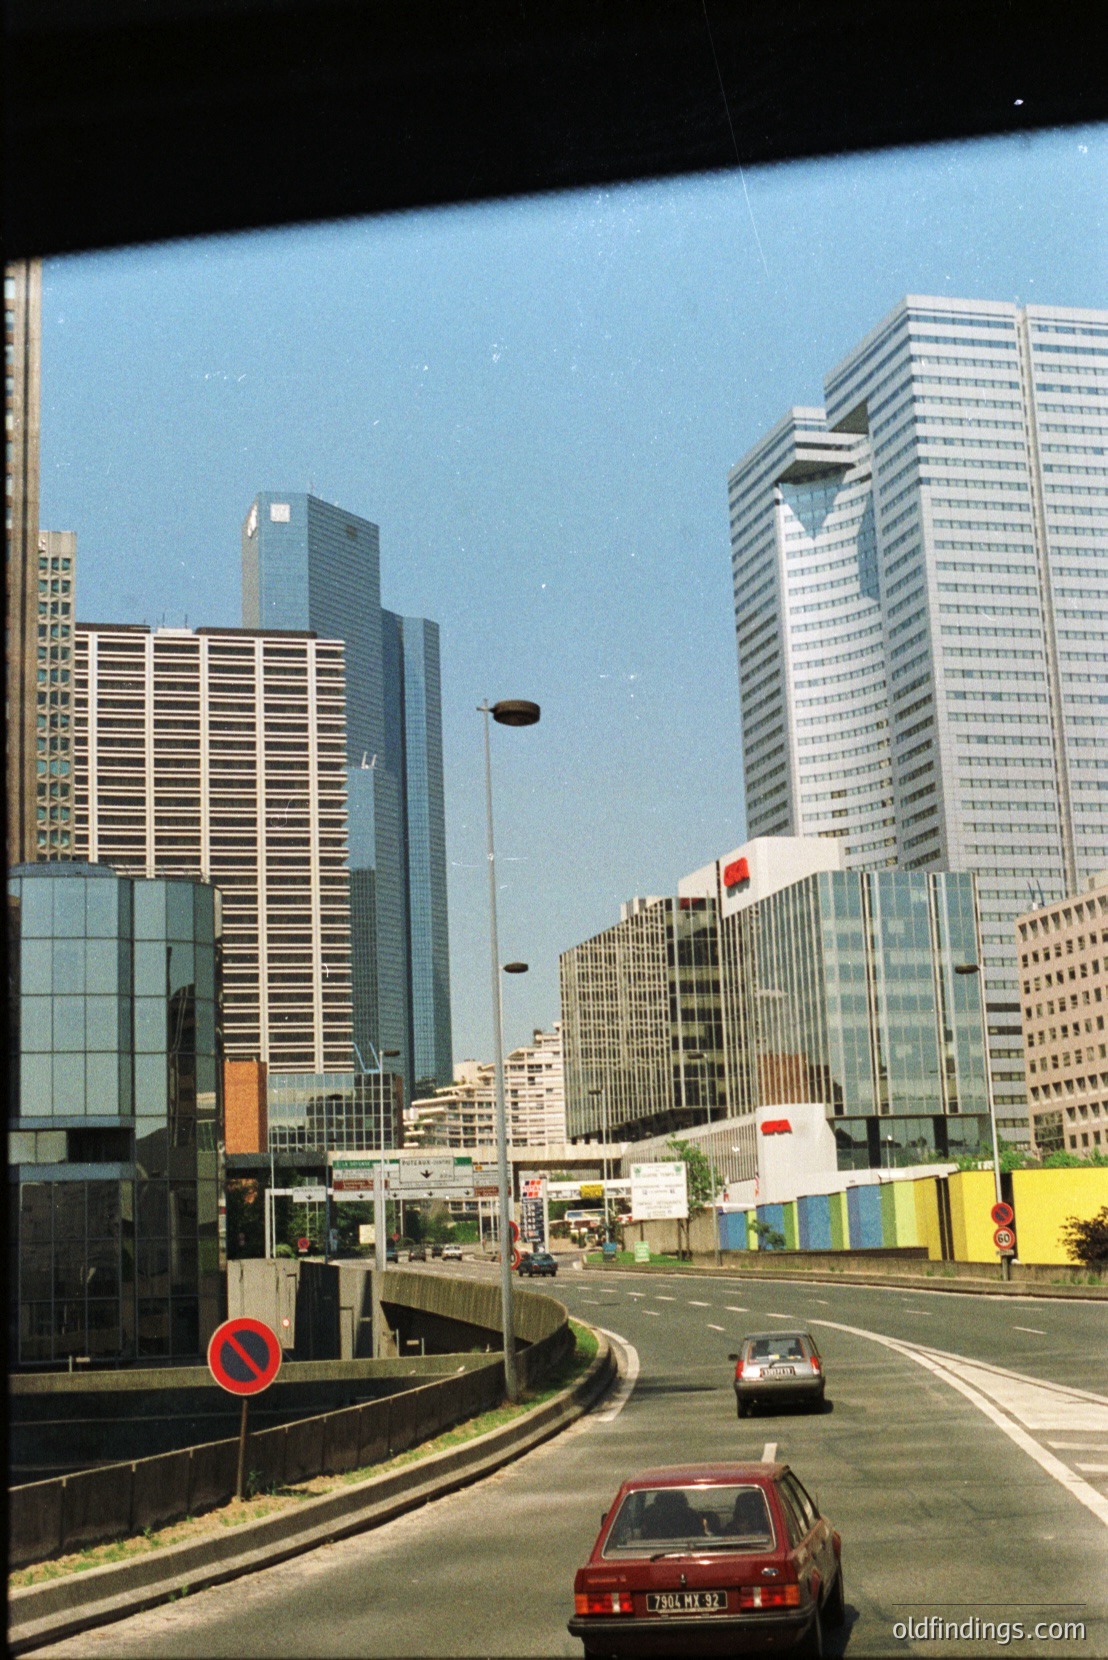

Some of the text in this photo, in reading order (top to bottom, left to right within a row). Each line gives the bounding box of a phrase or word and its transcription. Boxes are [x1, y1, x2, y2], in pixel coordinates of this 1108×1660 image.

[997, 1233, 1010, 1243] 60
[654, 1593, 719, 1609] 7904 MX 92
